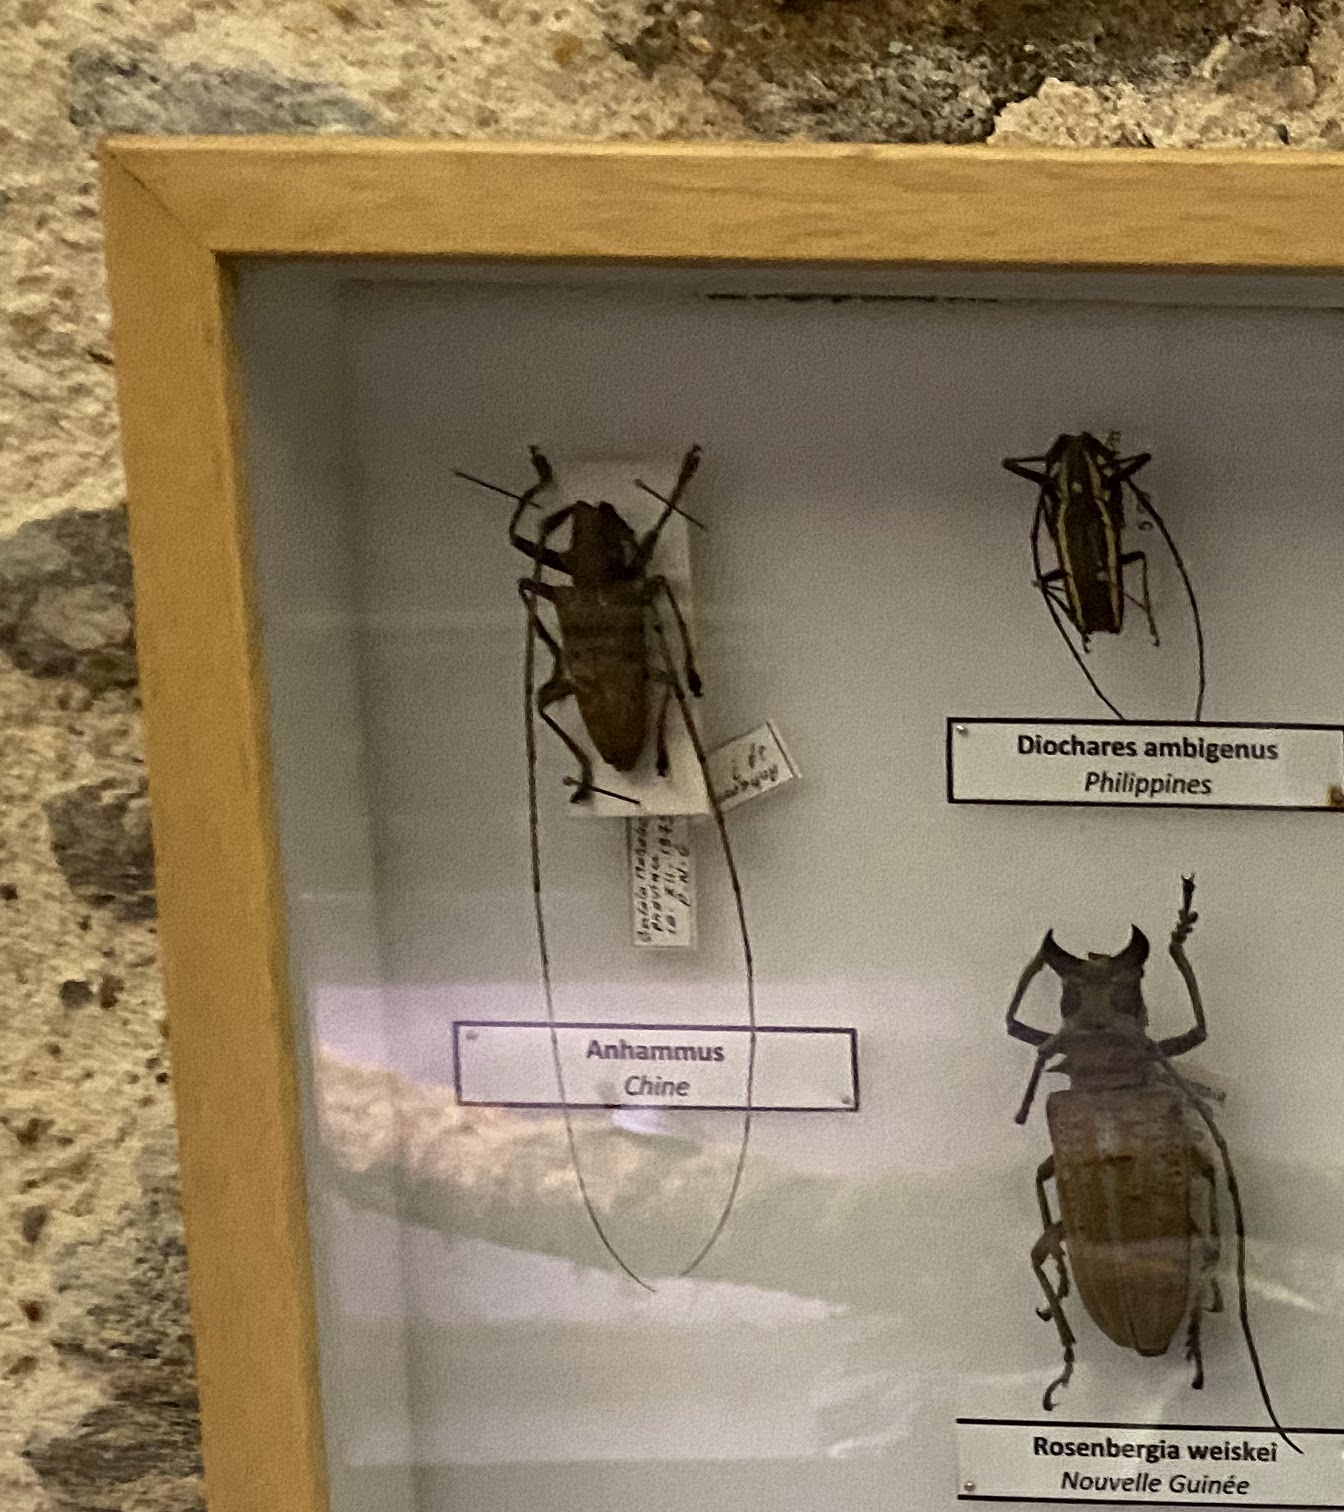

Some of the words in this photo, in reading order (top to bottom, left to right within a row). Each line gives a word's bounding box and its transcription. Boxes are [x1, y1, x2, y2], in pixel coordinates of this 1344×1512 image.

[1017, 736, 1138, 757] Diochares
[1143, 738, 1278, 763] ambigenus
[1084, 772, 1212, 796] Philippines
[586, 1041, 725, 1061] Anhammus
[624, 1076, 691, 1097] Chine
[1033, 1437, 1180, 1463] Rosenbergia
[1187, 1442, 1277, 1462] weiskei
[1061, 1472, 1163, 1493] Nouvelle
[1169, 1475, 1250, 1495] Guinée
